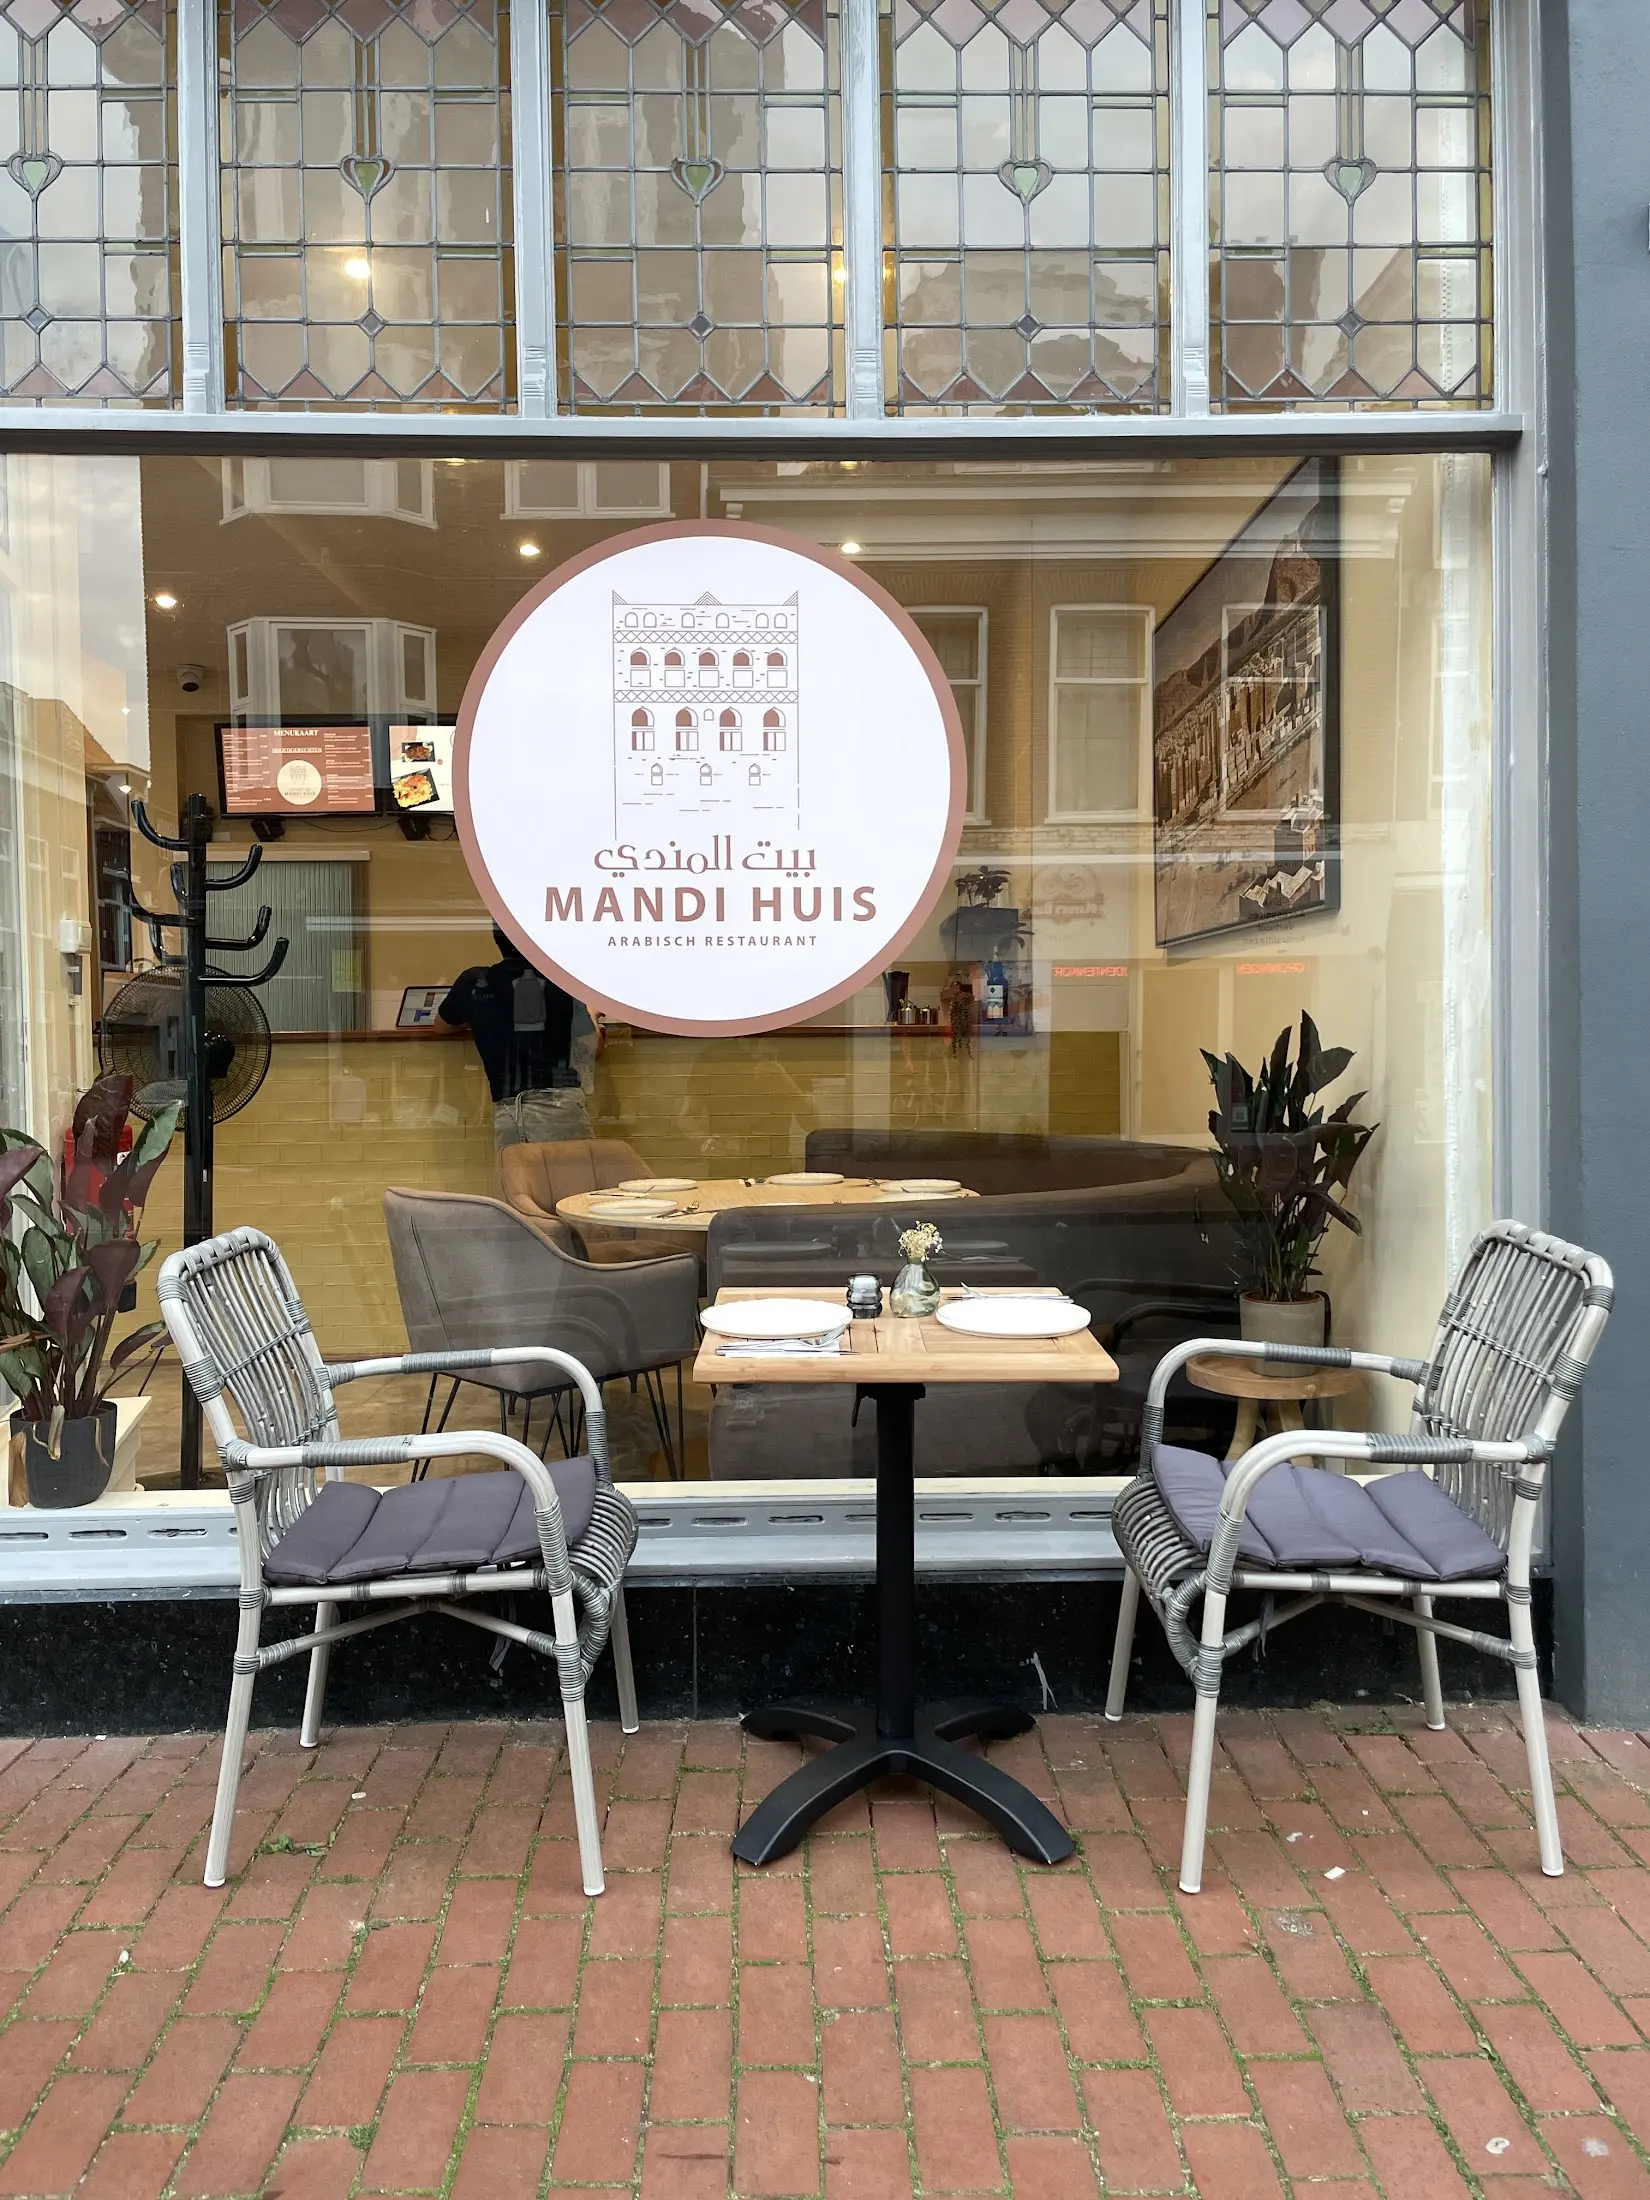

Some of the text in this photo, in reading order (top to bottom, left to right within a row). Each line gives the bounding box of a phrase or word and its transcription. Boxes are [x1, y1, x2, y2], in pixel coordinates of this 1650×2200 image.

[273, 729, 319, 737] MENUKAART
[594, 834, 816, 878] بيت المندي
[545, 887, 876, 922] MANDI HUIS
[608, 936, 817, 947] ARABISCH RESTAURANT
